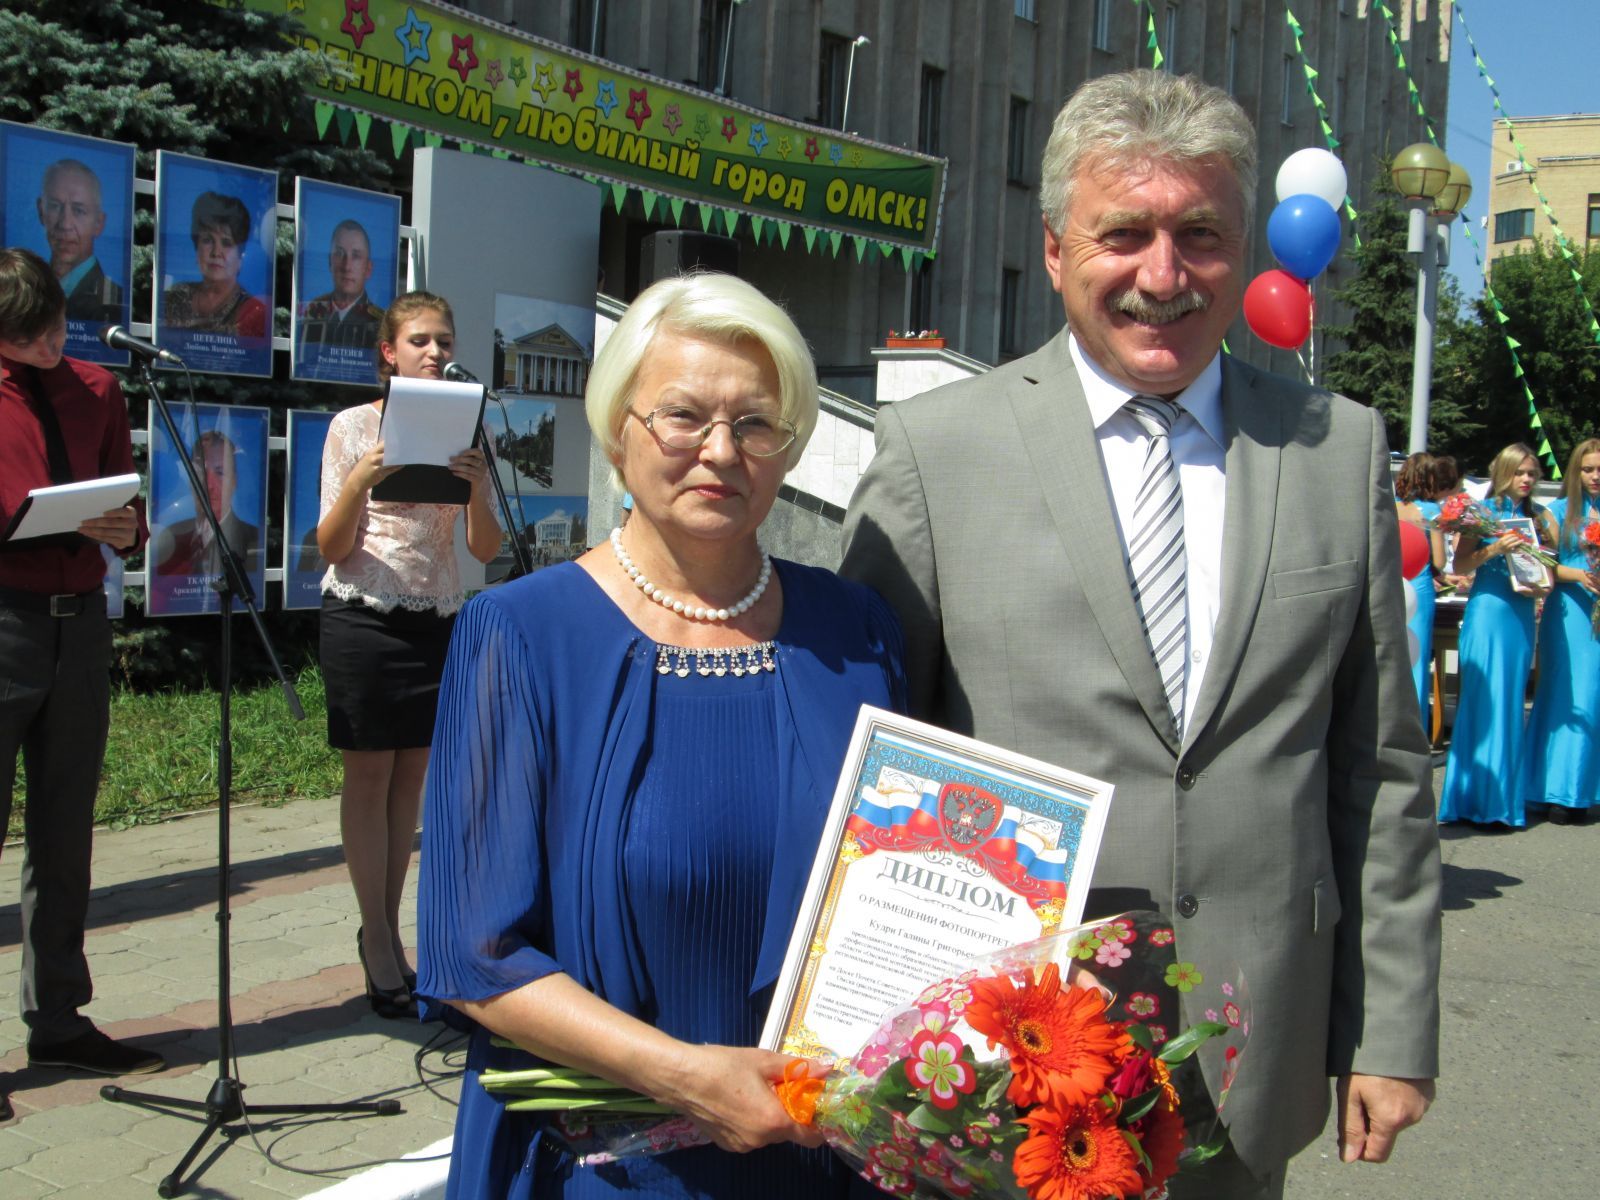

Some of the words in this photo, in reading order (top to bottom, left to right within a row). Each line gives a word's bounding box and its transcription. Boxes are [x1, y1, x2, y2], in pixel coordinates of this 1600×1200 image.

[516, 103, 701, 180] любимый
[712, 158, 807, 211] город
[859, 894, 867, 902] О
[868, 896, 938, 925] РАЗМЕЩЕНИИ
[876, 856, 1018, 918] ДИПЛОМ
[867, 919, 897, 936] Кудри
[896, 929, 931, 946] Галины
[930, 939, 976, 961] Григорьев
